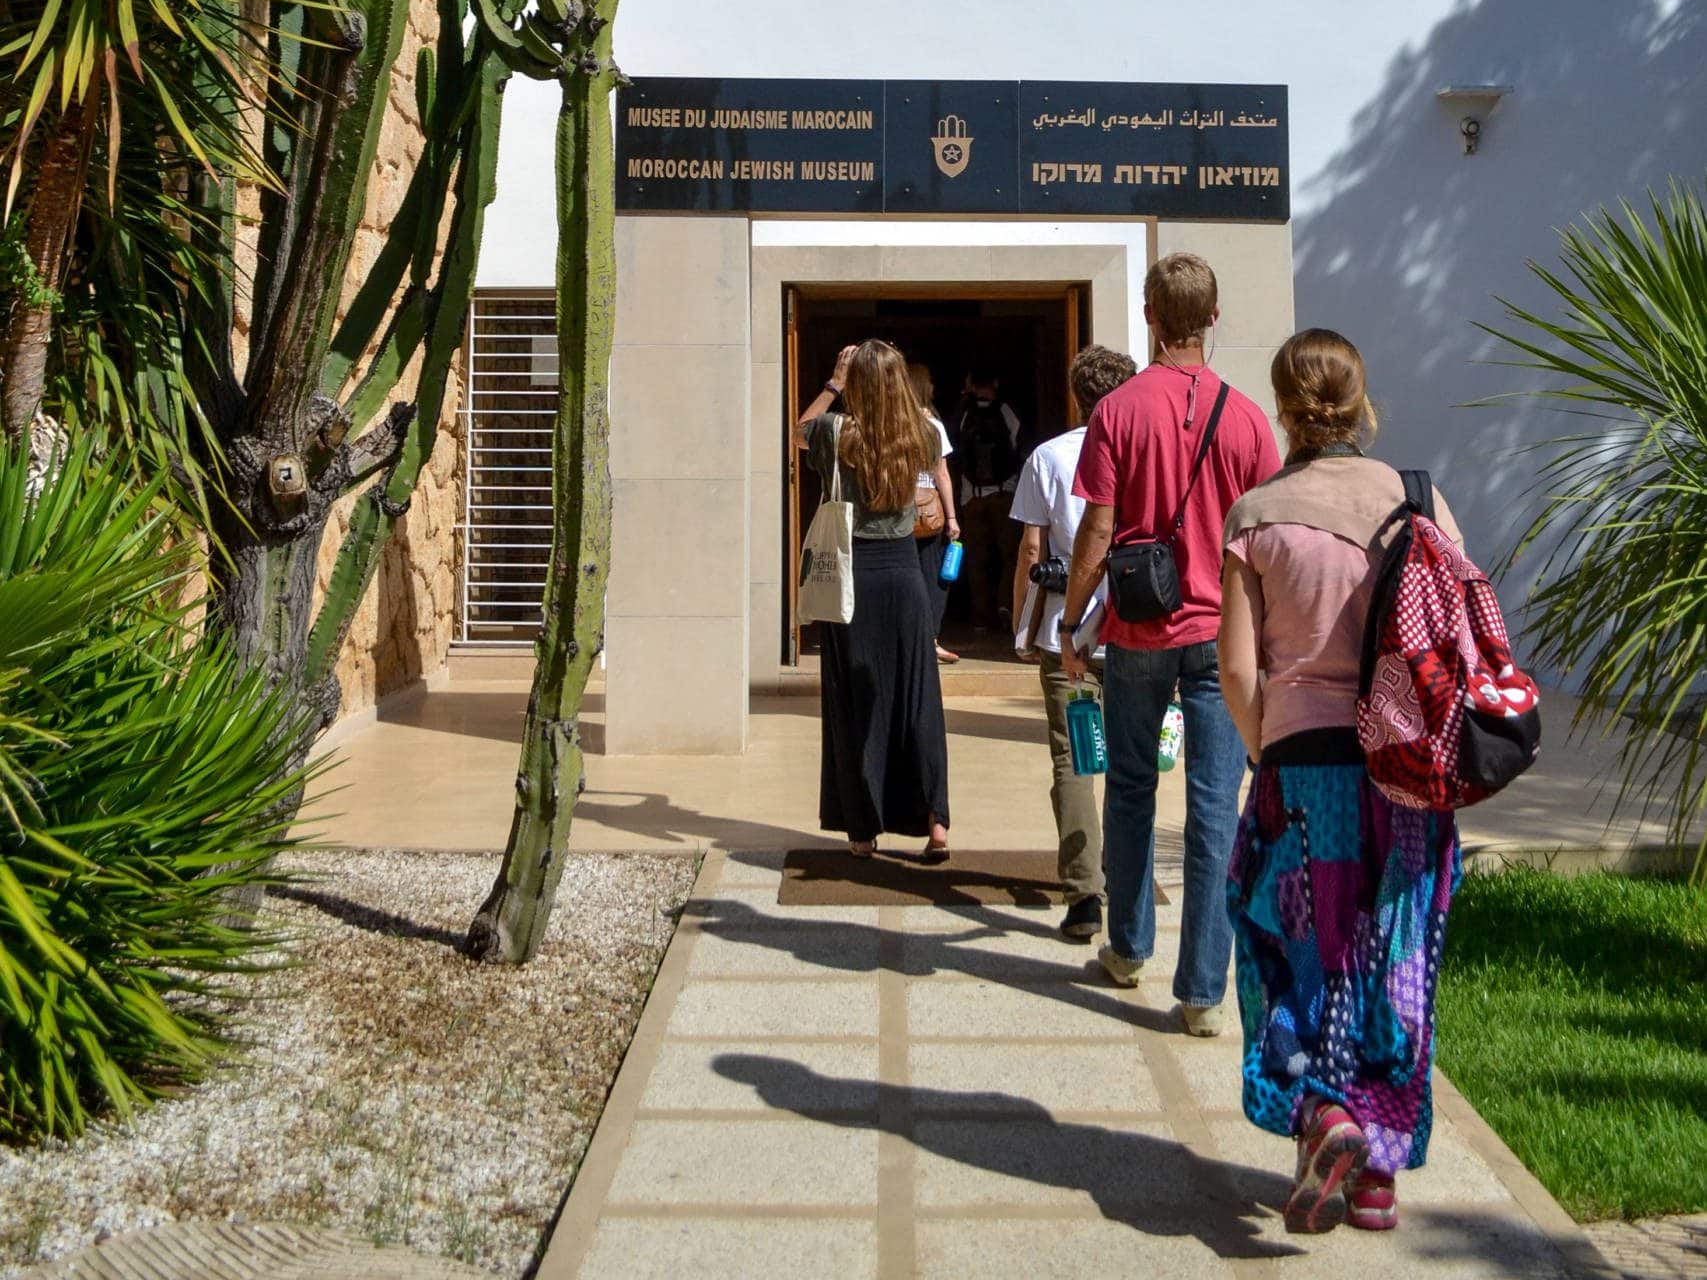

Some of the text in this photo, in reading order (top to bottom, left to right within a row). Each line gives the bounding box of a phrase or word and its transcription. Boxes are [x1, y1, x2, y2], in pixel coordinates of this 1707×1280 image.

[628, 107, 873, 130] MUSEE DU JUDAISME MAROCAIN
[1032, 107, 1278, 132] متحف التراث اليهودي المغربي
[628, 158, 874, 181] MOROCCAN JEWISH MUSEUM
[1032, 162, 1279, 189] מוזיאון יהדות מרוקו
